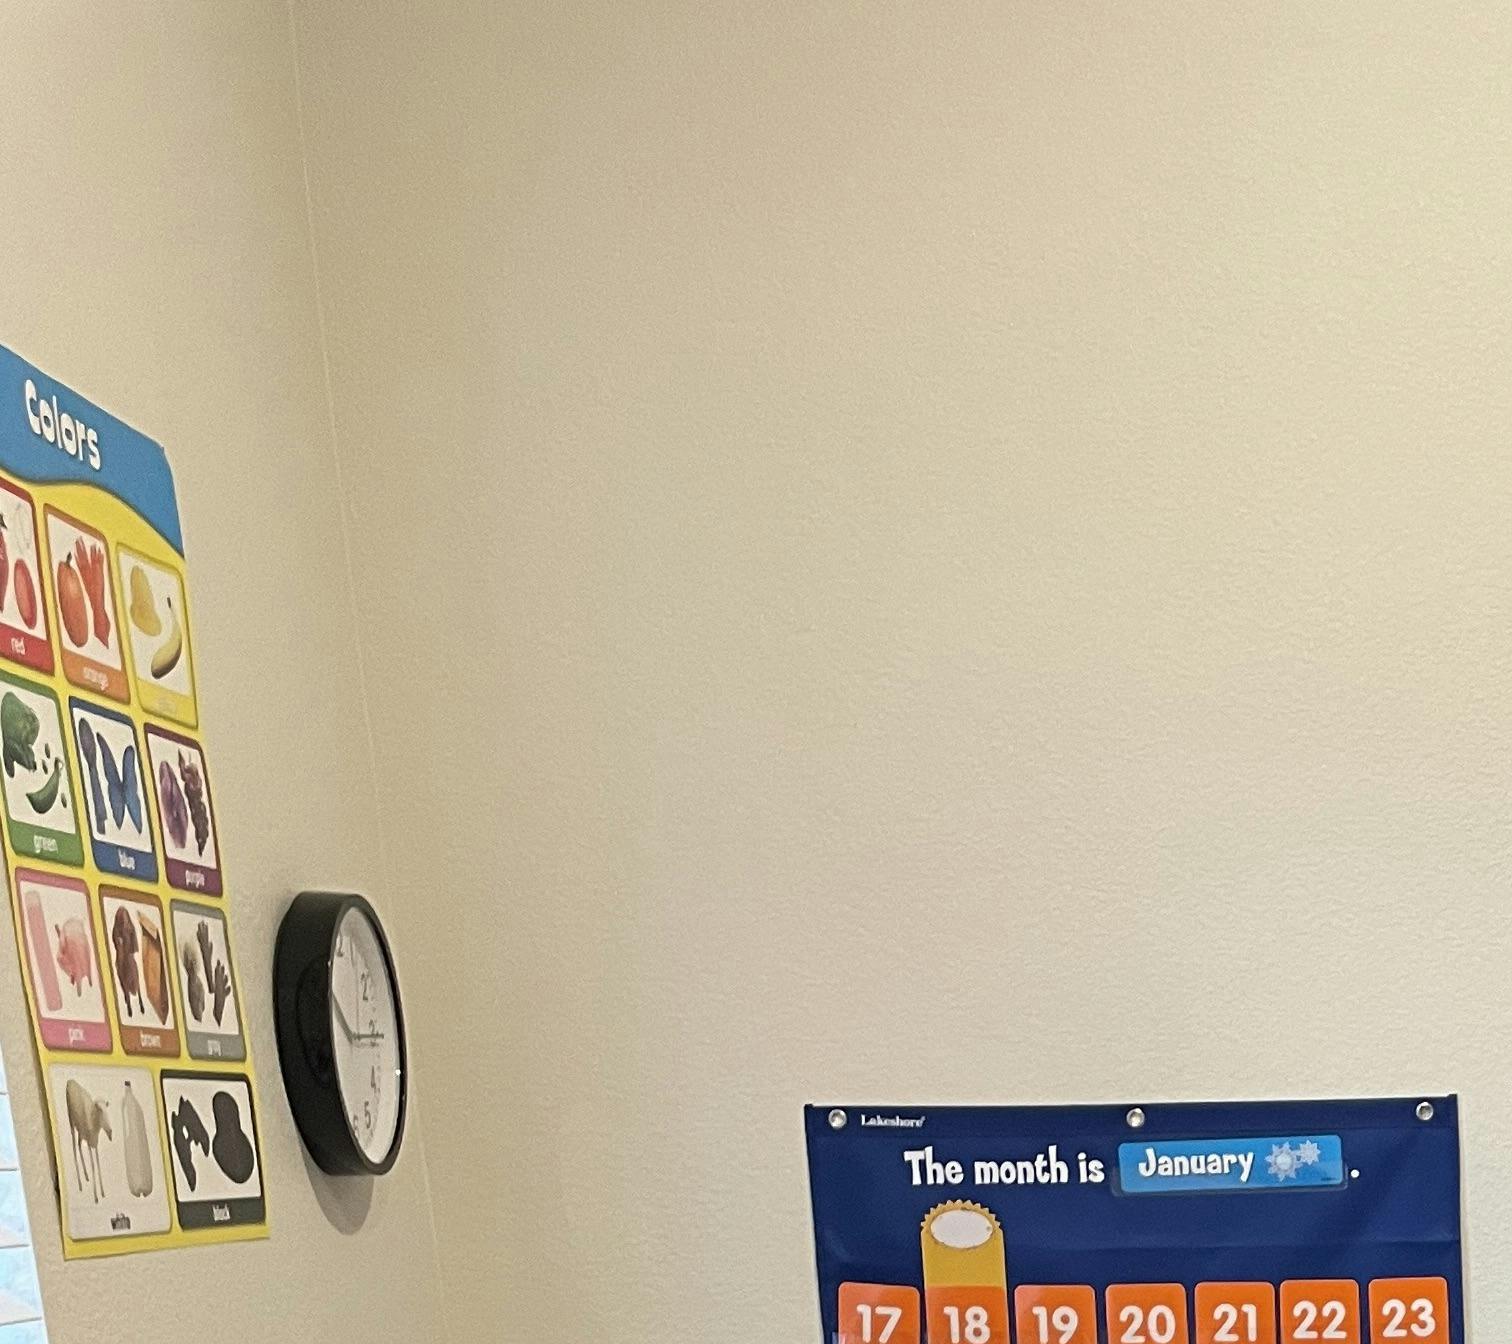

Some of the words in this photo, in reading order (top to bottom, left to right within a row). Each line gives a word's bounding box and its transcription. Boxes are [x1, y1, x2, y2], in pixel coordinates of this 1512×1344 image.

[25, 379, 101, 470] Colors
[904, 1146, 964, 1185] The
[973, 1145, 1068, 1184] month
[1077, 1152, 1105, 1184] is
[1138, 1148, 1255, 1183] January
[1119, 1304, 1177, 1344] 20
[1213, 1303, 1258, 1344] 21
[1292, 1299, 1347, 1341] 22
[1382, 1297, 1437, 1339] 23
